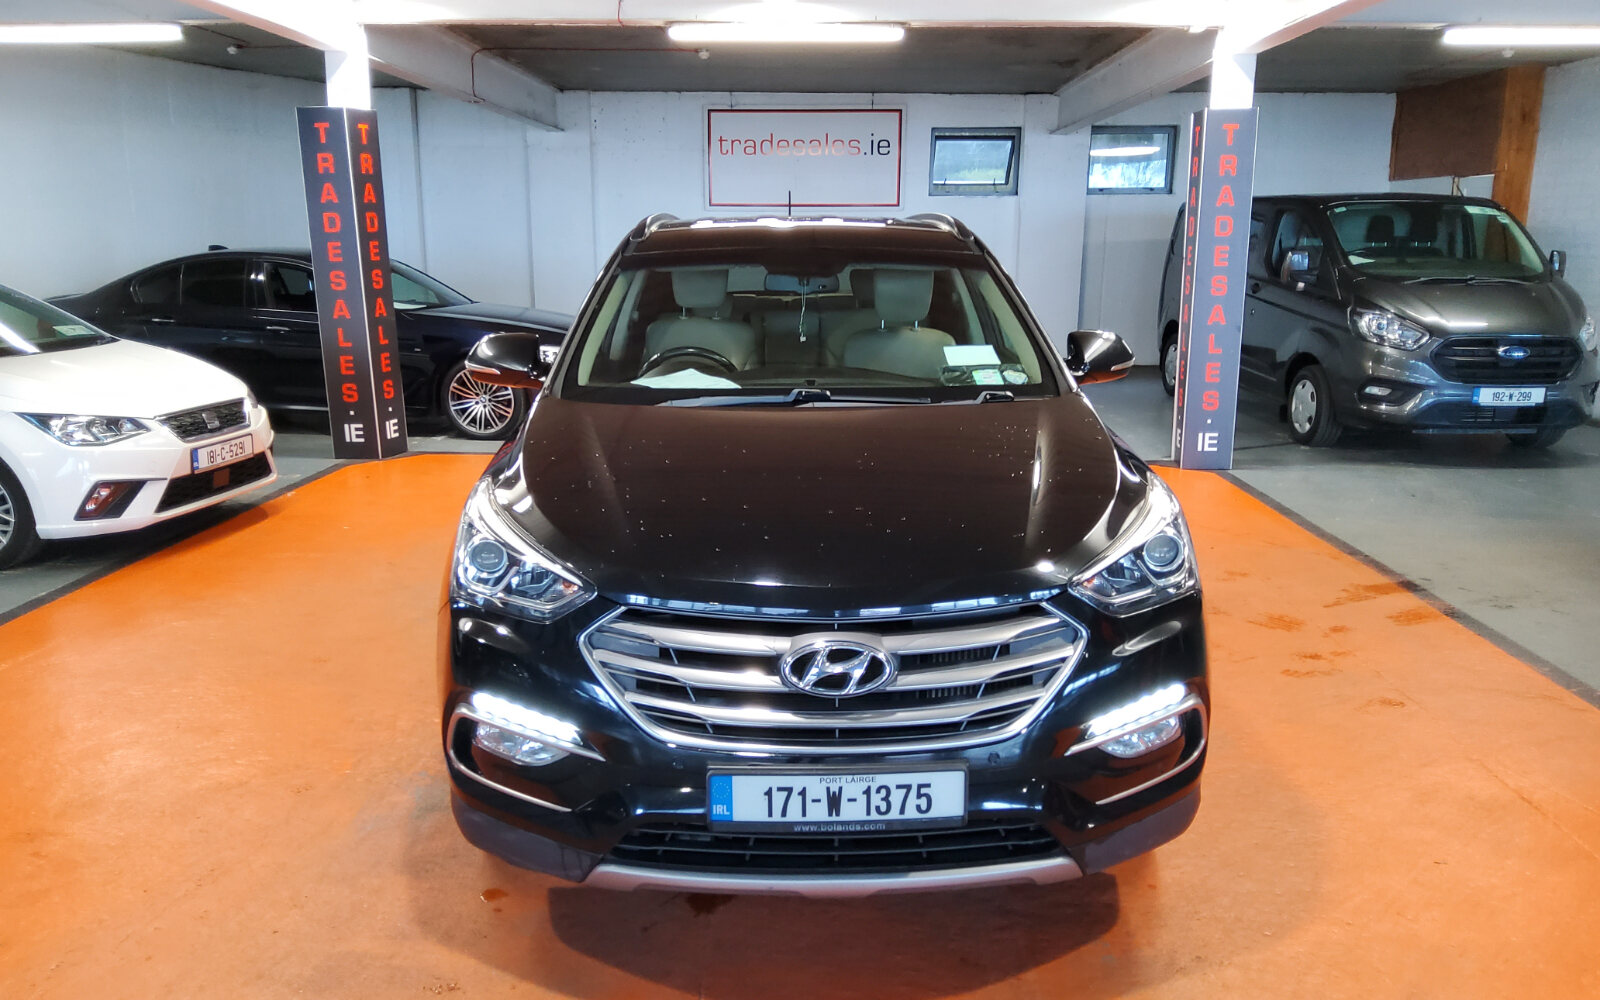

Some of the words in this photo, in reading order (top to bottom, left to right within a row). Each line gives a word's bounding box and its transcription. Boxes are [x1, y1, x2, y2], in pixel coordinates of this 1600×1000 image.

[717, 132, 891, 156] tradesales.ie
[1492, 391, 1532, 401] 192-W-299
[206, 440, 246, 465] 181-C-5291
[819, 776, 843, 784] PORT
[763, 783, 933, 818] 171-W-1375
[712, 804, 730, 815] IRL
[793, 822, 886, 832] www.bolands.com
